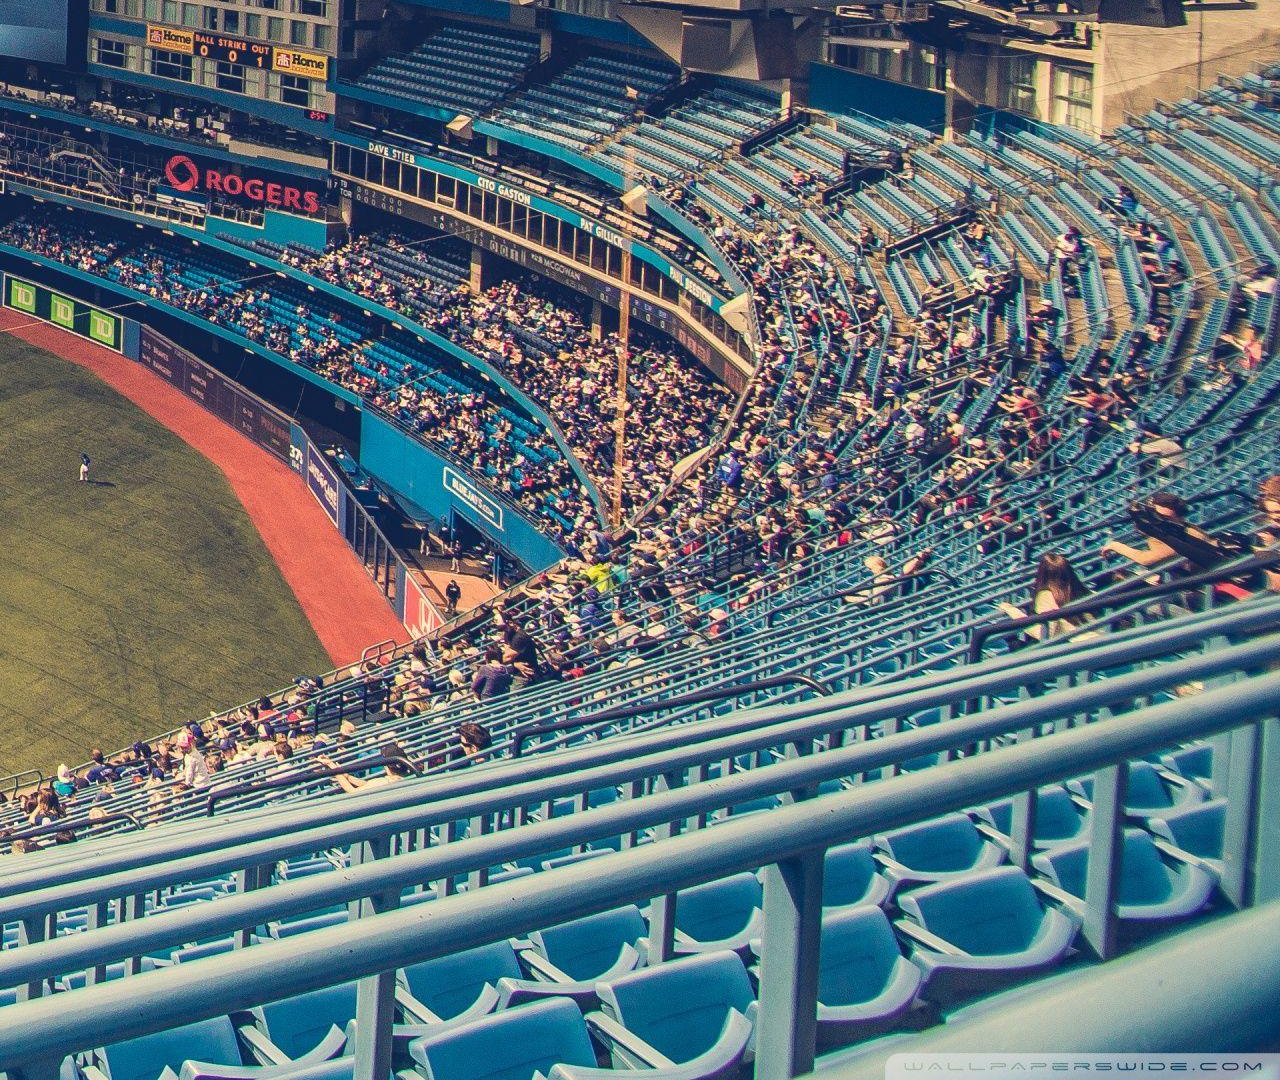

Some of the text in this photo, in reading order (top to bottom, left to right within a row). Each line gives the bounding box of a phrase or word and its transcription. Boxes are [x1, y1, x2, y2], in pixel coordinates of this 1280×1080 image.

[163, 29, 191, 44] Home
[195, 34, 270, 55] BALL STRIKE OUT
[200, 45, 263, 67] 0 0 1
[292, 53, 325, 69] Home
[369, 142, 415, 164] DAVE STIEB
[206, 170, 318, 213] ROGERS
[340, 188, 352, 198] TOR
[478, 177, 531, 205] CITO GASTON
[580, 218, 625, 248] PAT GILLICK
[15, 286, 33, 306] TD
[53, 300, 73, 321] TD
[93, 315, 113, 338] TD
